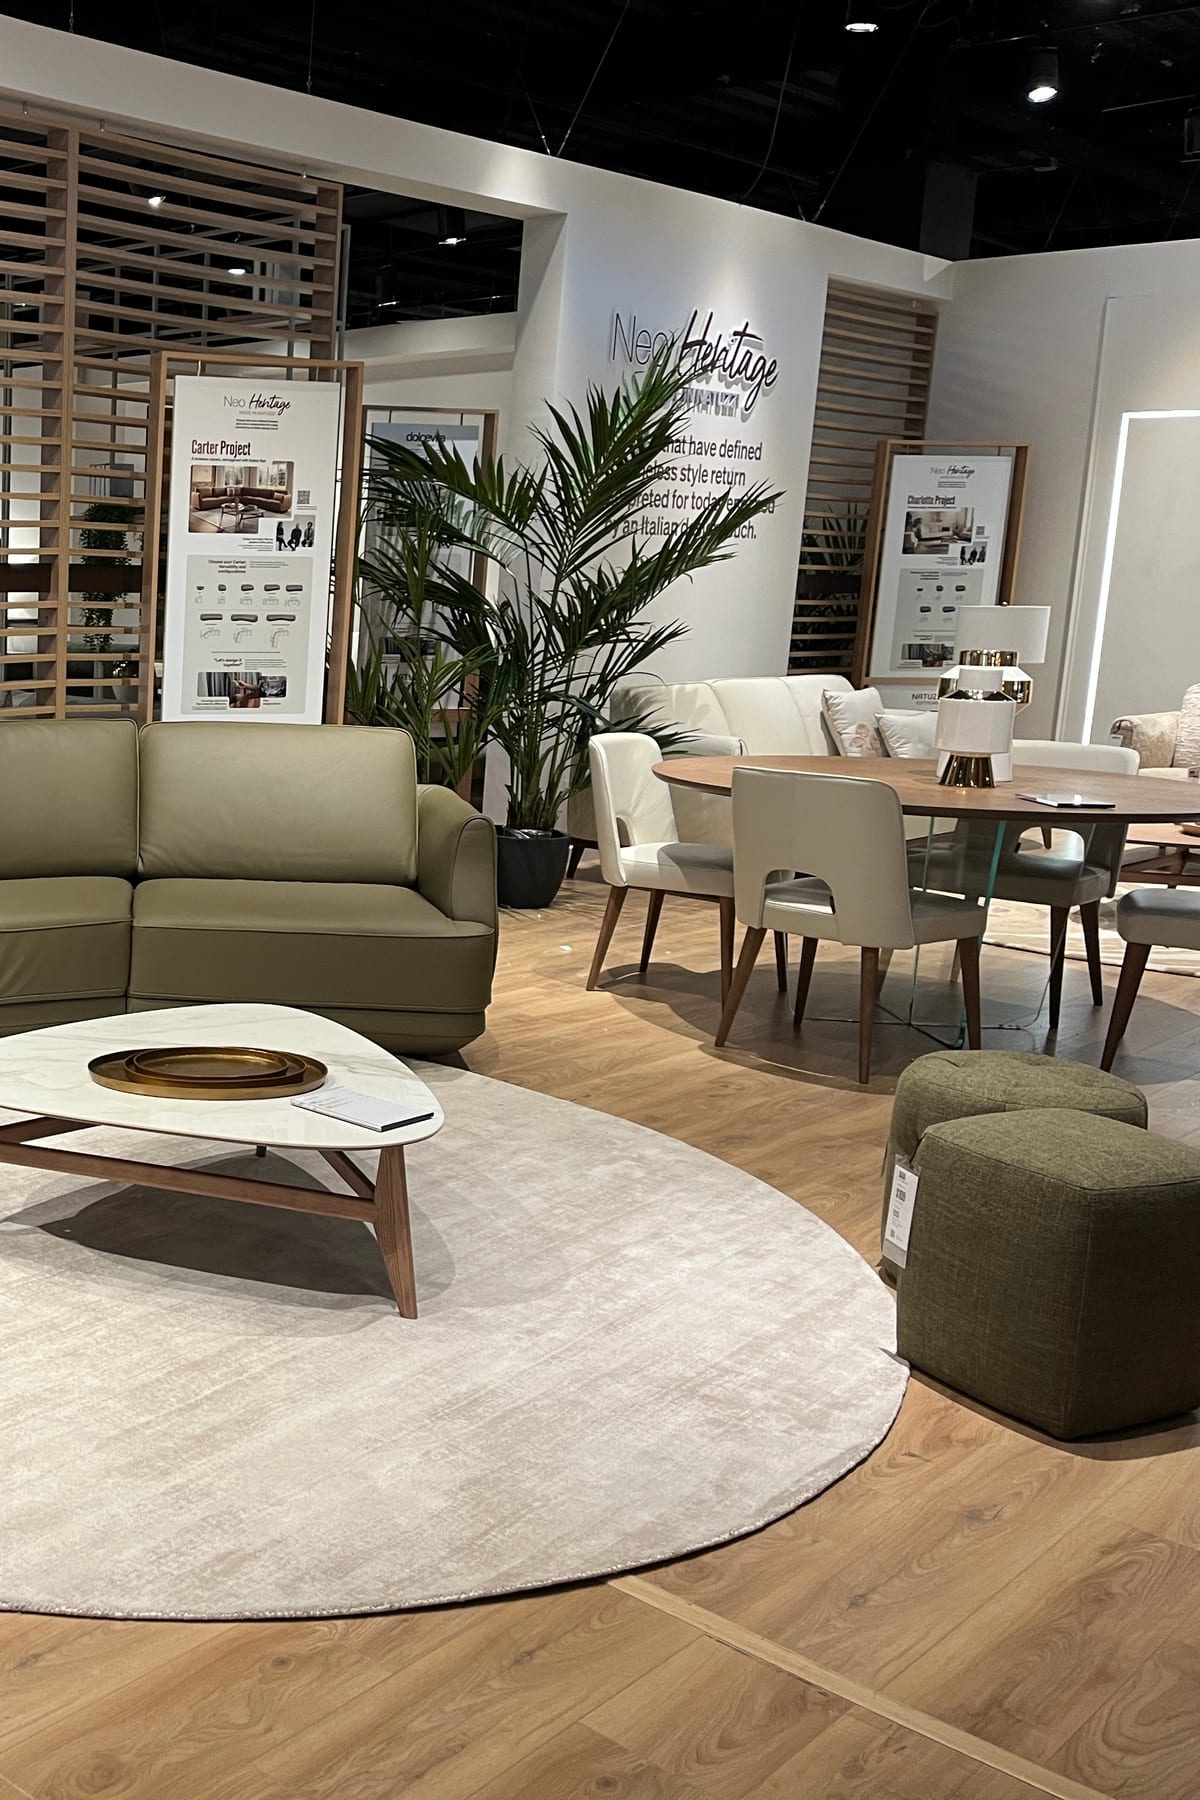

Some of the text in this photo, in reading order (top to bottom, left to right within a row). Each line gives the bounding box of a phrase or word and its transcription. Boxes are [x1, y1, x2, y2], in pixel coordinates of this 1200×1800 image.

[612, 309, 779, 412] Neo Heritage
[223, 393, 291, 415] Neo Heritage
[191, 439, 251, 458] Carter Project
[662, 435, 763, 461] hat have defined
[679, 464, 709, 487] style
[711, 469, 746, 486] return
[672, 489, 690, 509] for
[935, 495, 956, 507] Project
[640, 515, 678, 536] Italian
